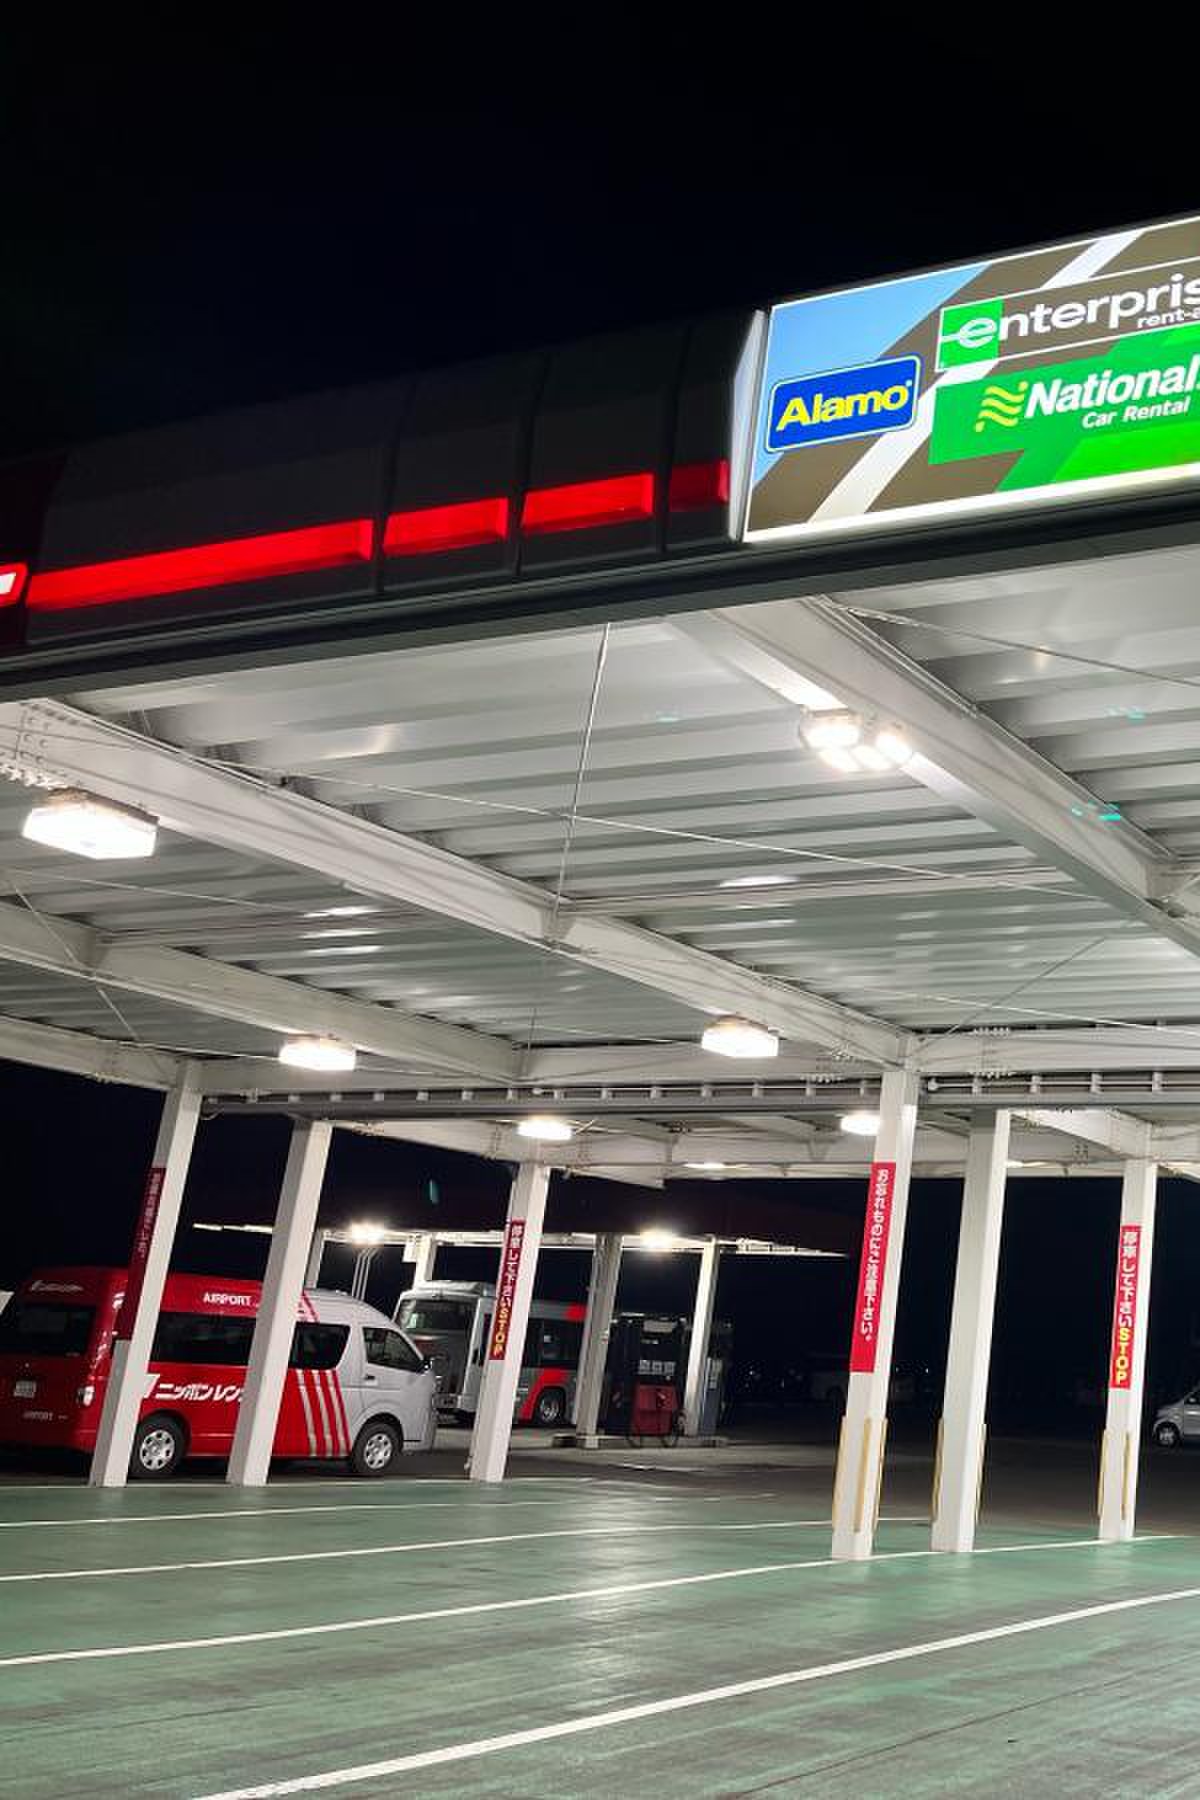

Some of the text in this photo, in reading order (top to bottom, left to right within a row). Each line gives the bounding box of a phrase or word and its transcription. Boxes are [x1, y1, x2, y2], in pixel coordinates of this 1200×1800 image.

[776, 385, 909, 431] Alamo
[1082, 396, 1191, 429] Car Rental
[1115, 1327, 1131, 1385] STOP
[155, 1383, 245, 1402] ニッポンレン
